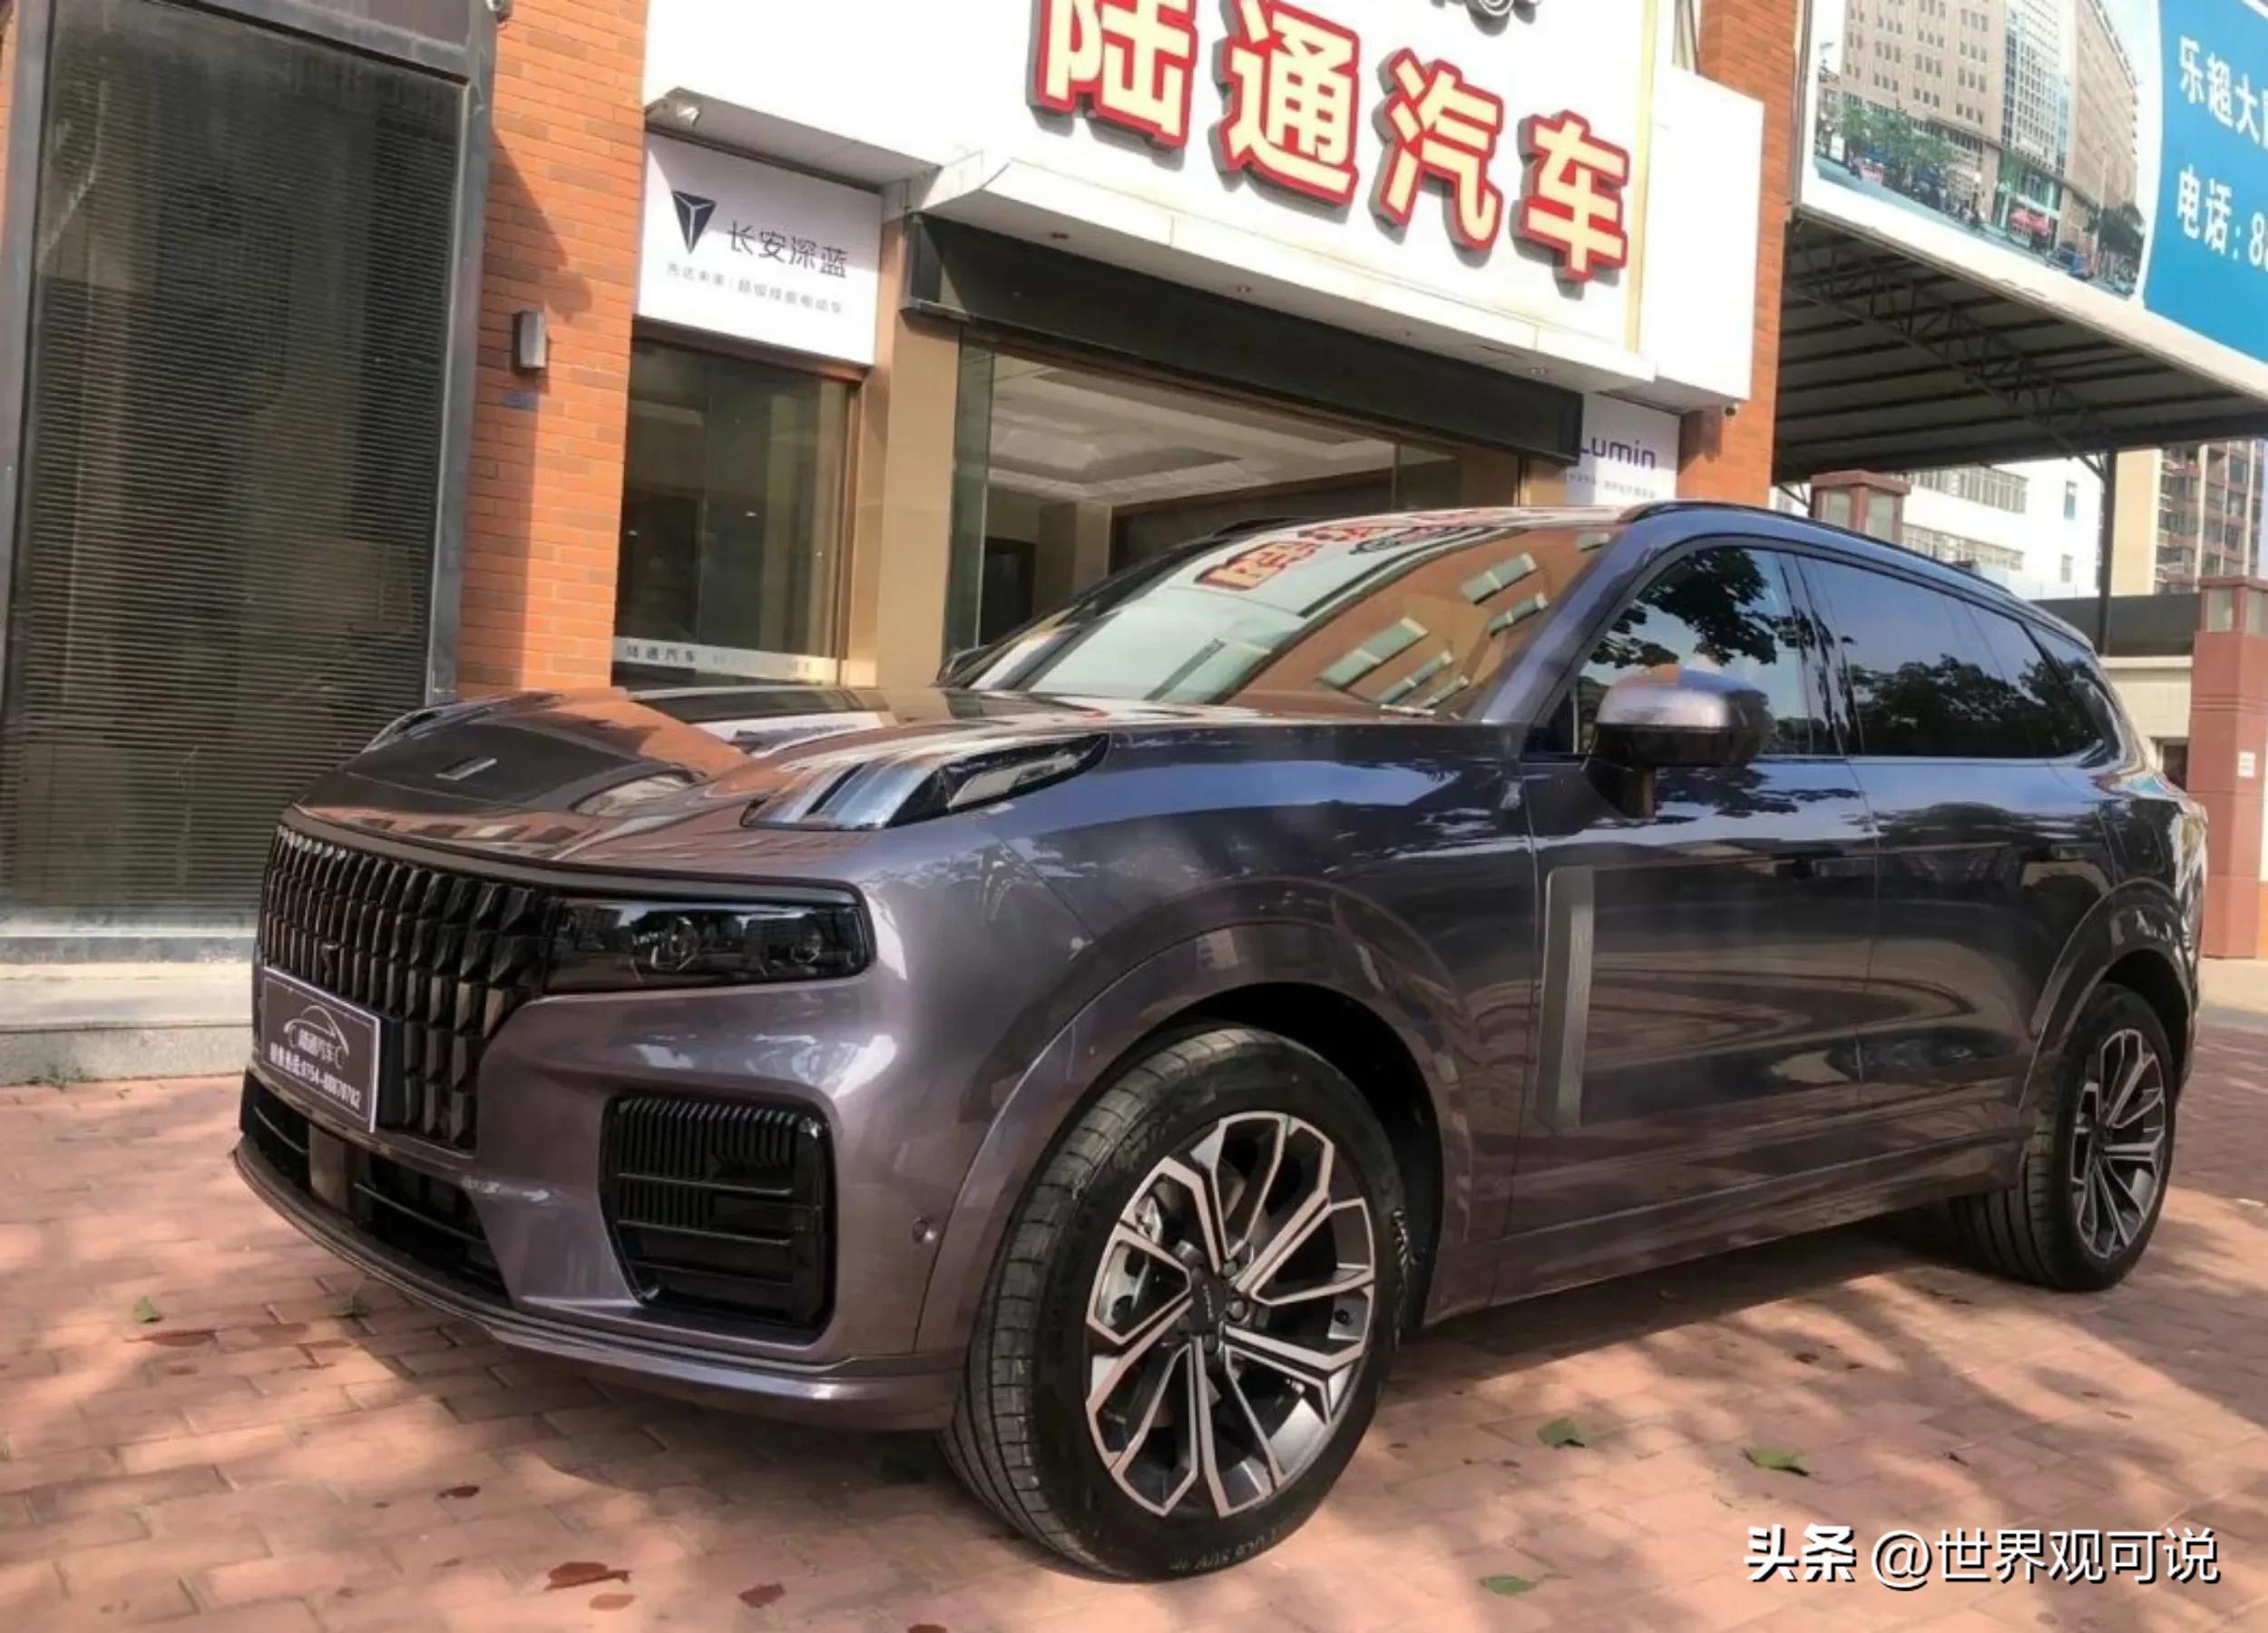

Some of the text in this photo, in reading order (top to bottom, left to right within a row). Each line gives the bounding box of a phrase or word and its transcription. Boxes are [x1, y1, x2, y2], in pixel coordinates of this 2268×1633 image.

[1033, 0, 1630, 279] 陆通汽车
[728, 220, 848, 279] 长安深蓝
[2177, 163, 2268, 272] 电话:8
